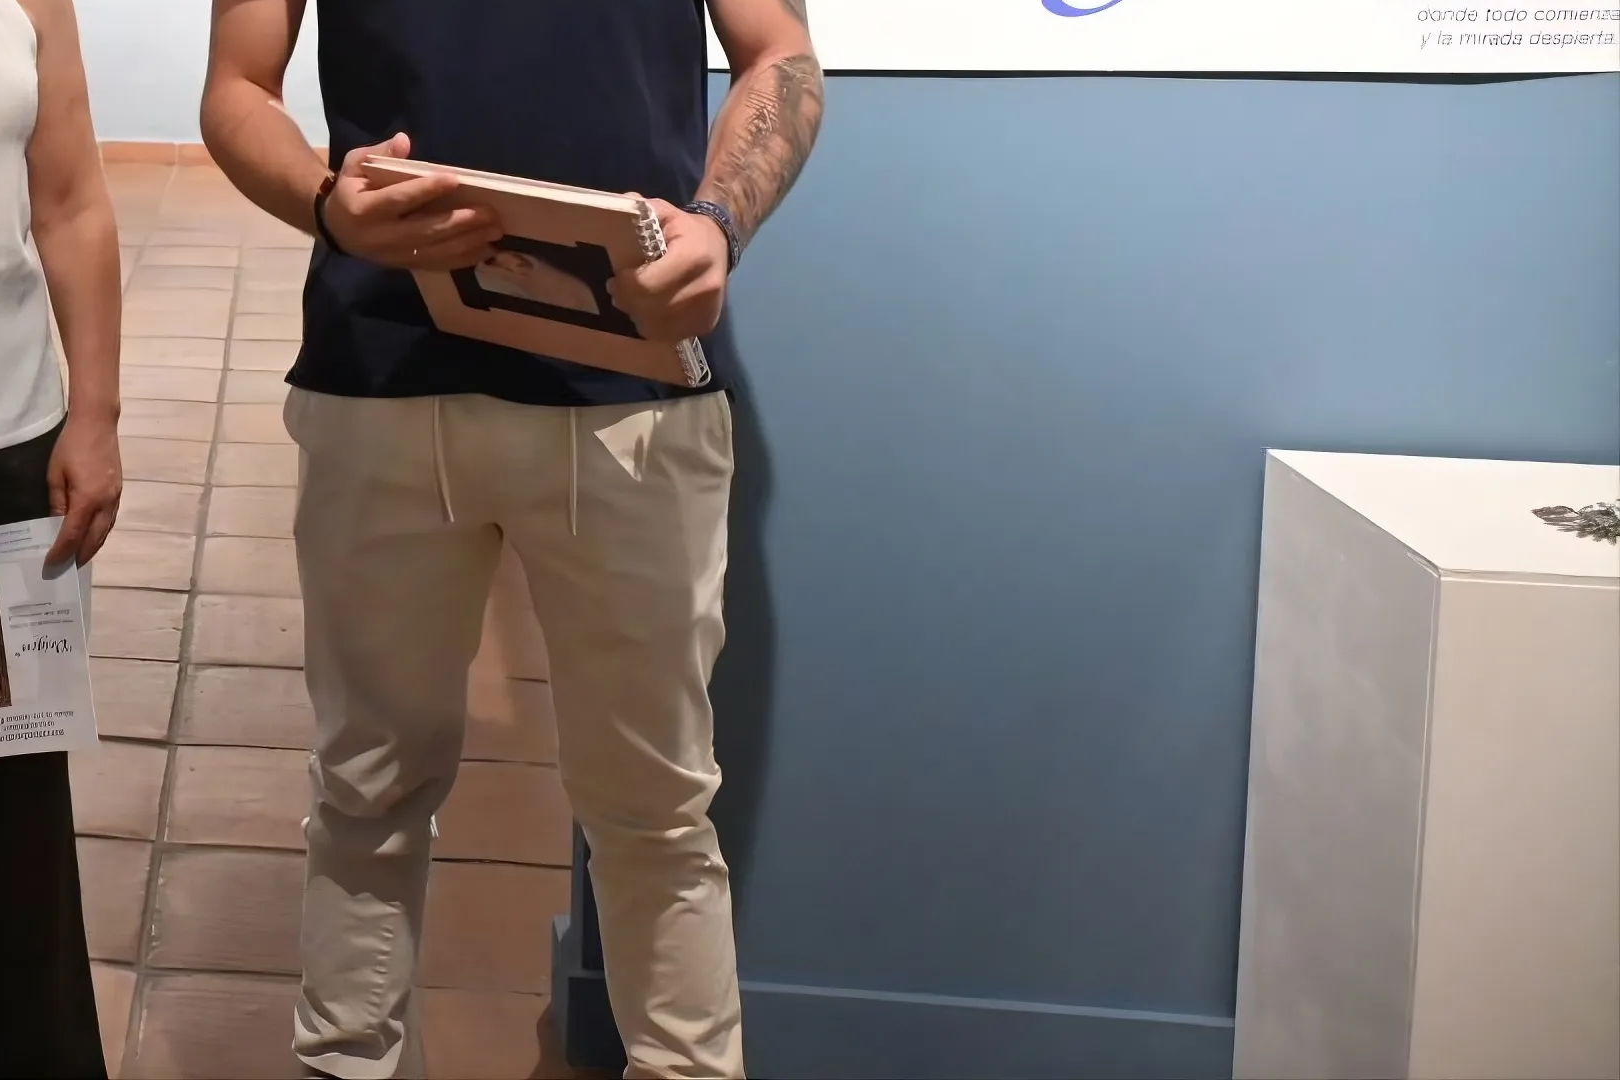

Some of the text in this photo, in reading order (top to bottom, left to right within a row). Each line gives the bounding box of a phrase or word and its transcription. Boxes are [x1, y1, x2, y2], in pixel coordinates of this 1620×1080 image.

[1417, 7, 1478, 22] donde
[1485, 7, 1528, 22] todo
[1420, 32, 1432, 49] y
[1437, 30, 1453, 46] la
[1459, 29, 1523, 46] mirada
